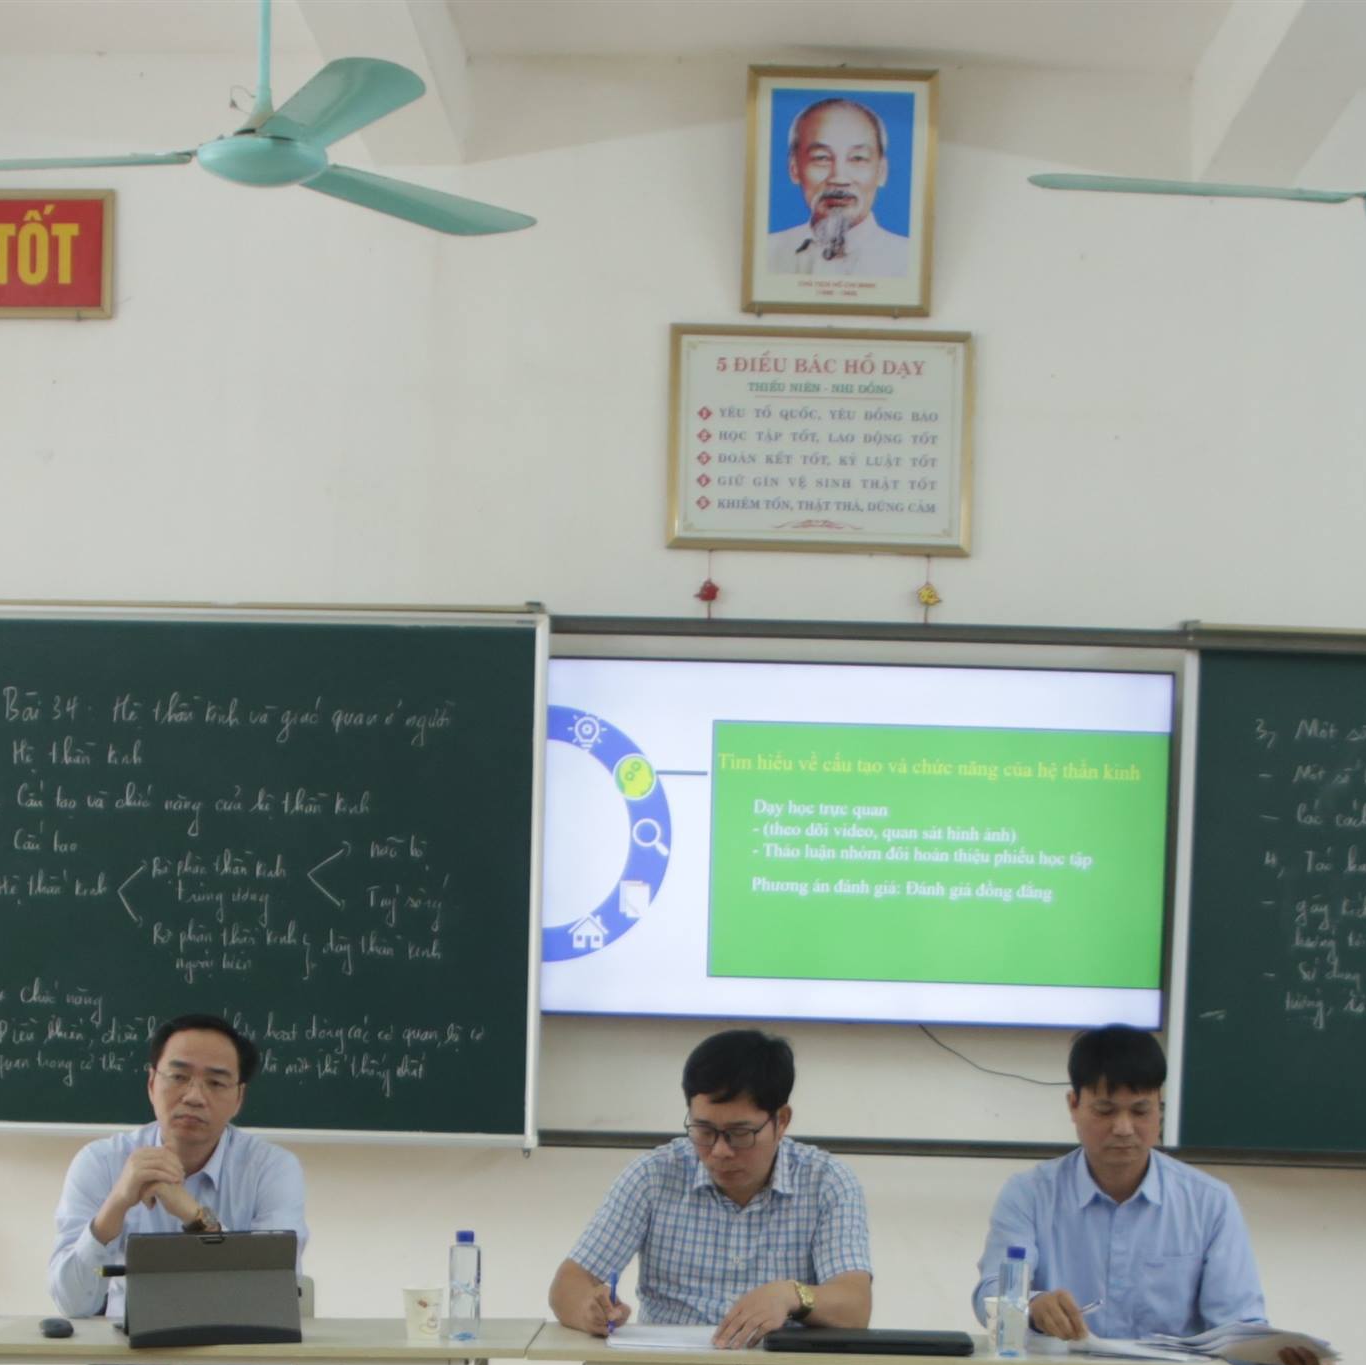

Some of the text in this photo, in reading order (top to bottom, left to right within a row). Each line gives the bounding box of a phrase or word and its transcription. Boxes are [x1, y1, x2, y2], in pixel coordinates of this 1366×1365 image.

[716, 357, 728, 373] 5
[795, 354, 837, 374] BÁC
[882, 359, 926, 379] DẠY
[3, 686, 42, 722] Bài
[331, 708, 378, 733] quan
[107, 738, 143, 766] kinh
[753, 799, 889, 821] Dạy học trực quan
